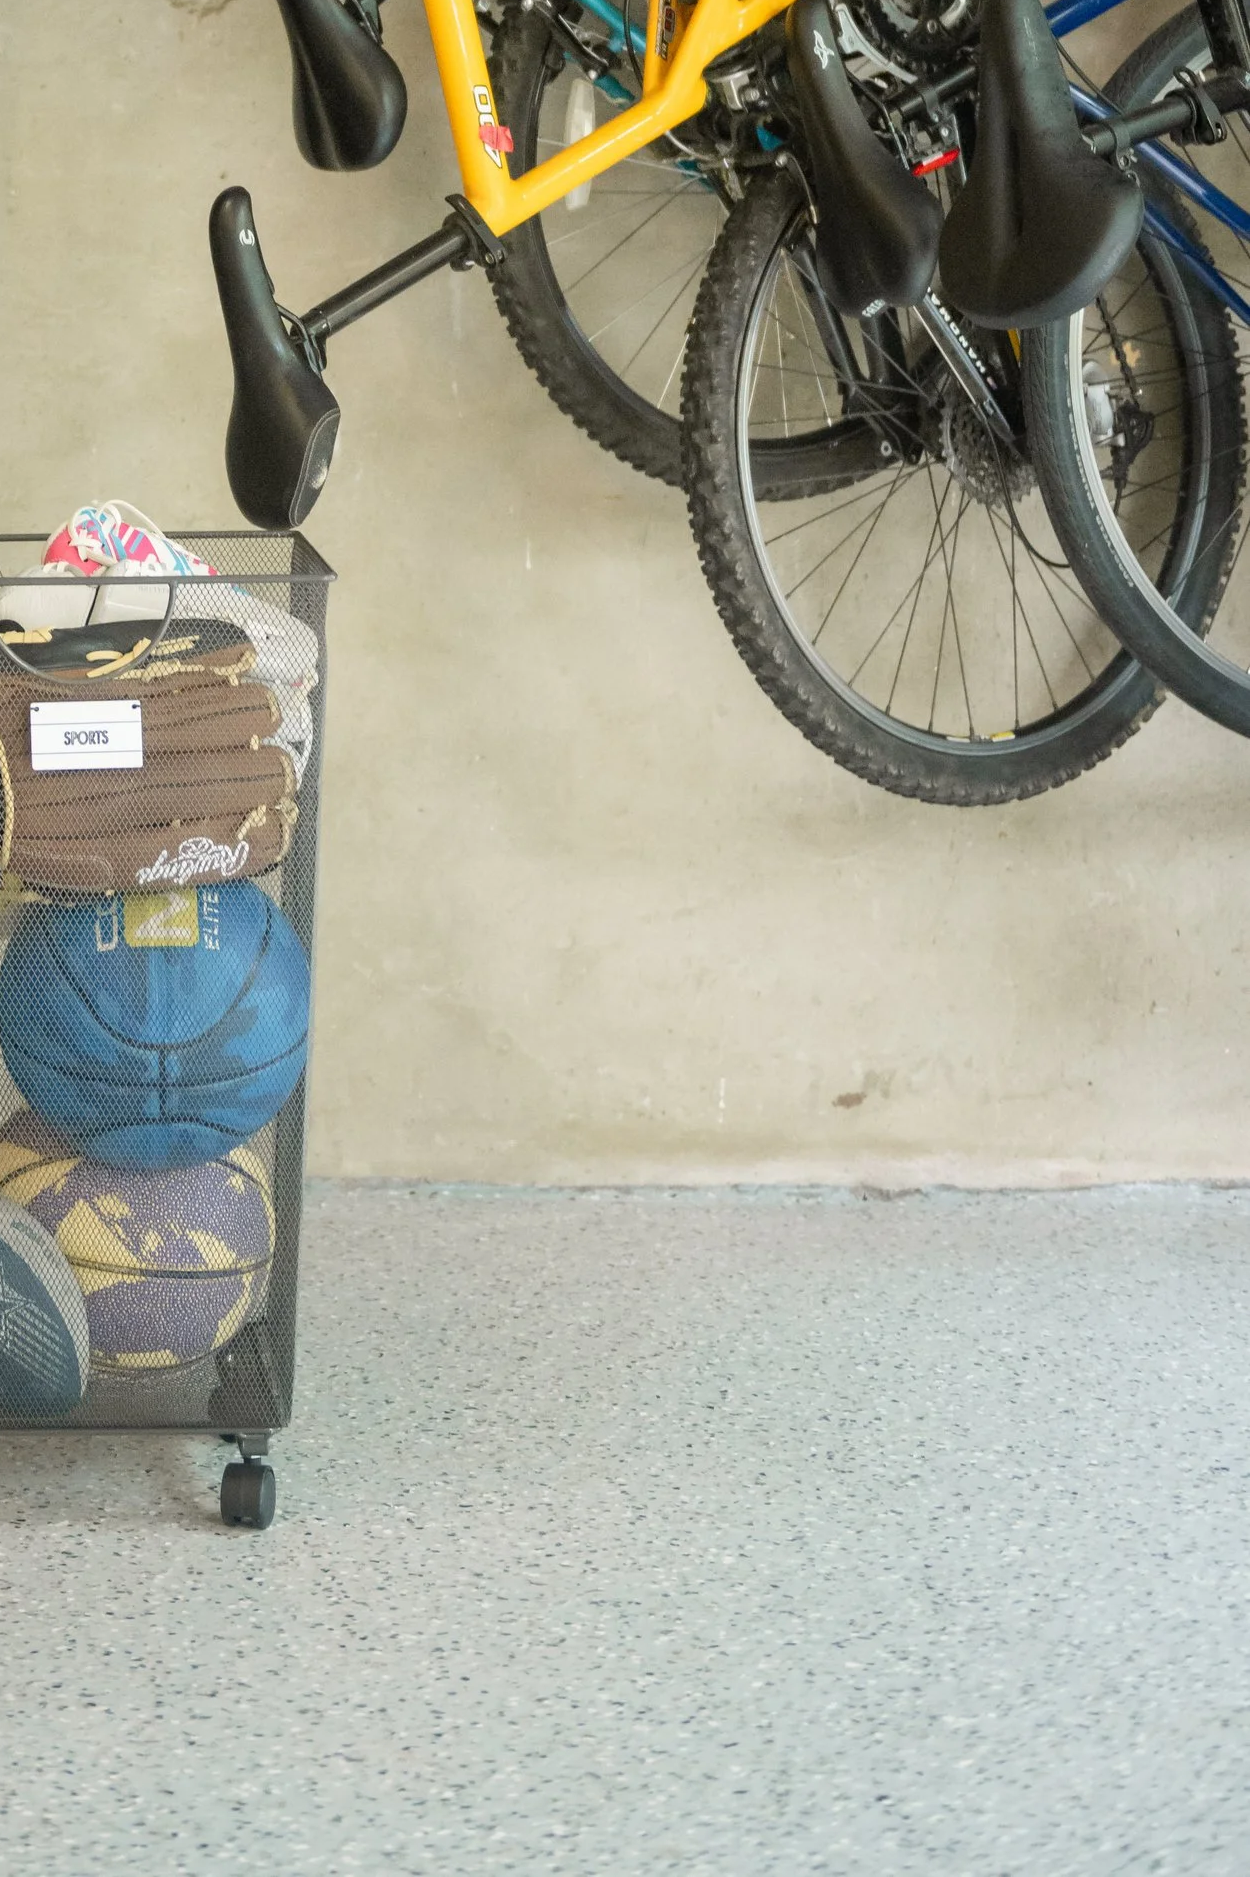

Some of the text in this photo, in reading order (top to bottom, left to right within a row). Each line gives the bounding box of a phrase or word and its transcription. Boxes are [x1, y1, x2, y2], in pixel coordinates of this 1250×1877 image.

[927, 286, 986, 374] HANDMA
[63, 729, 110, 746] SPORTS
[135, 837, 250, 886] Rawlings
[202, 890, 221, 952] ELITE
